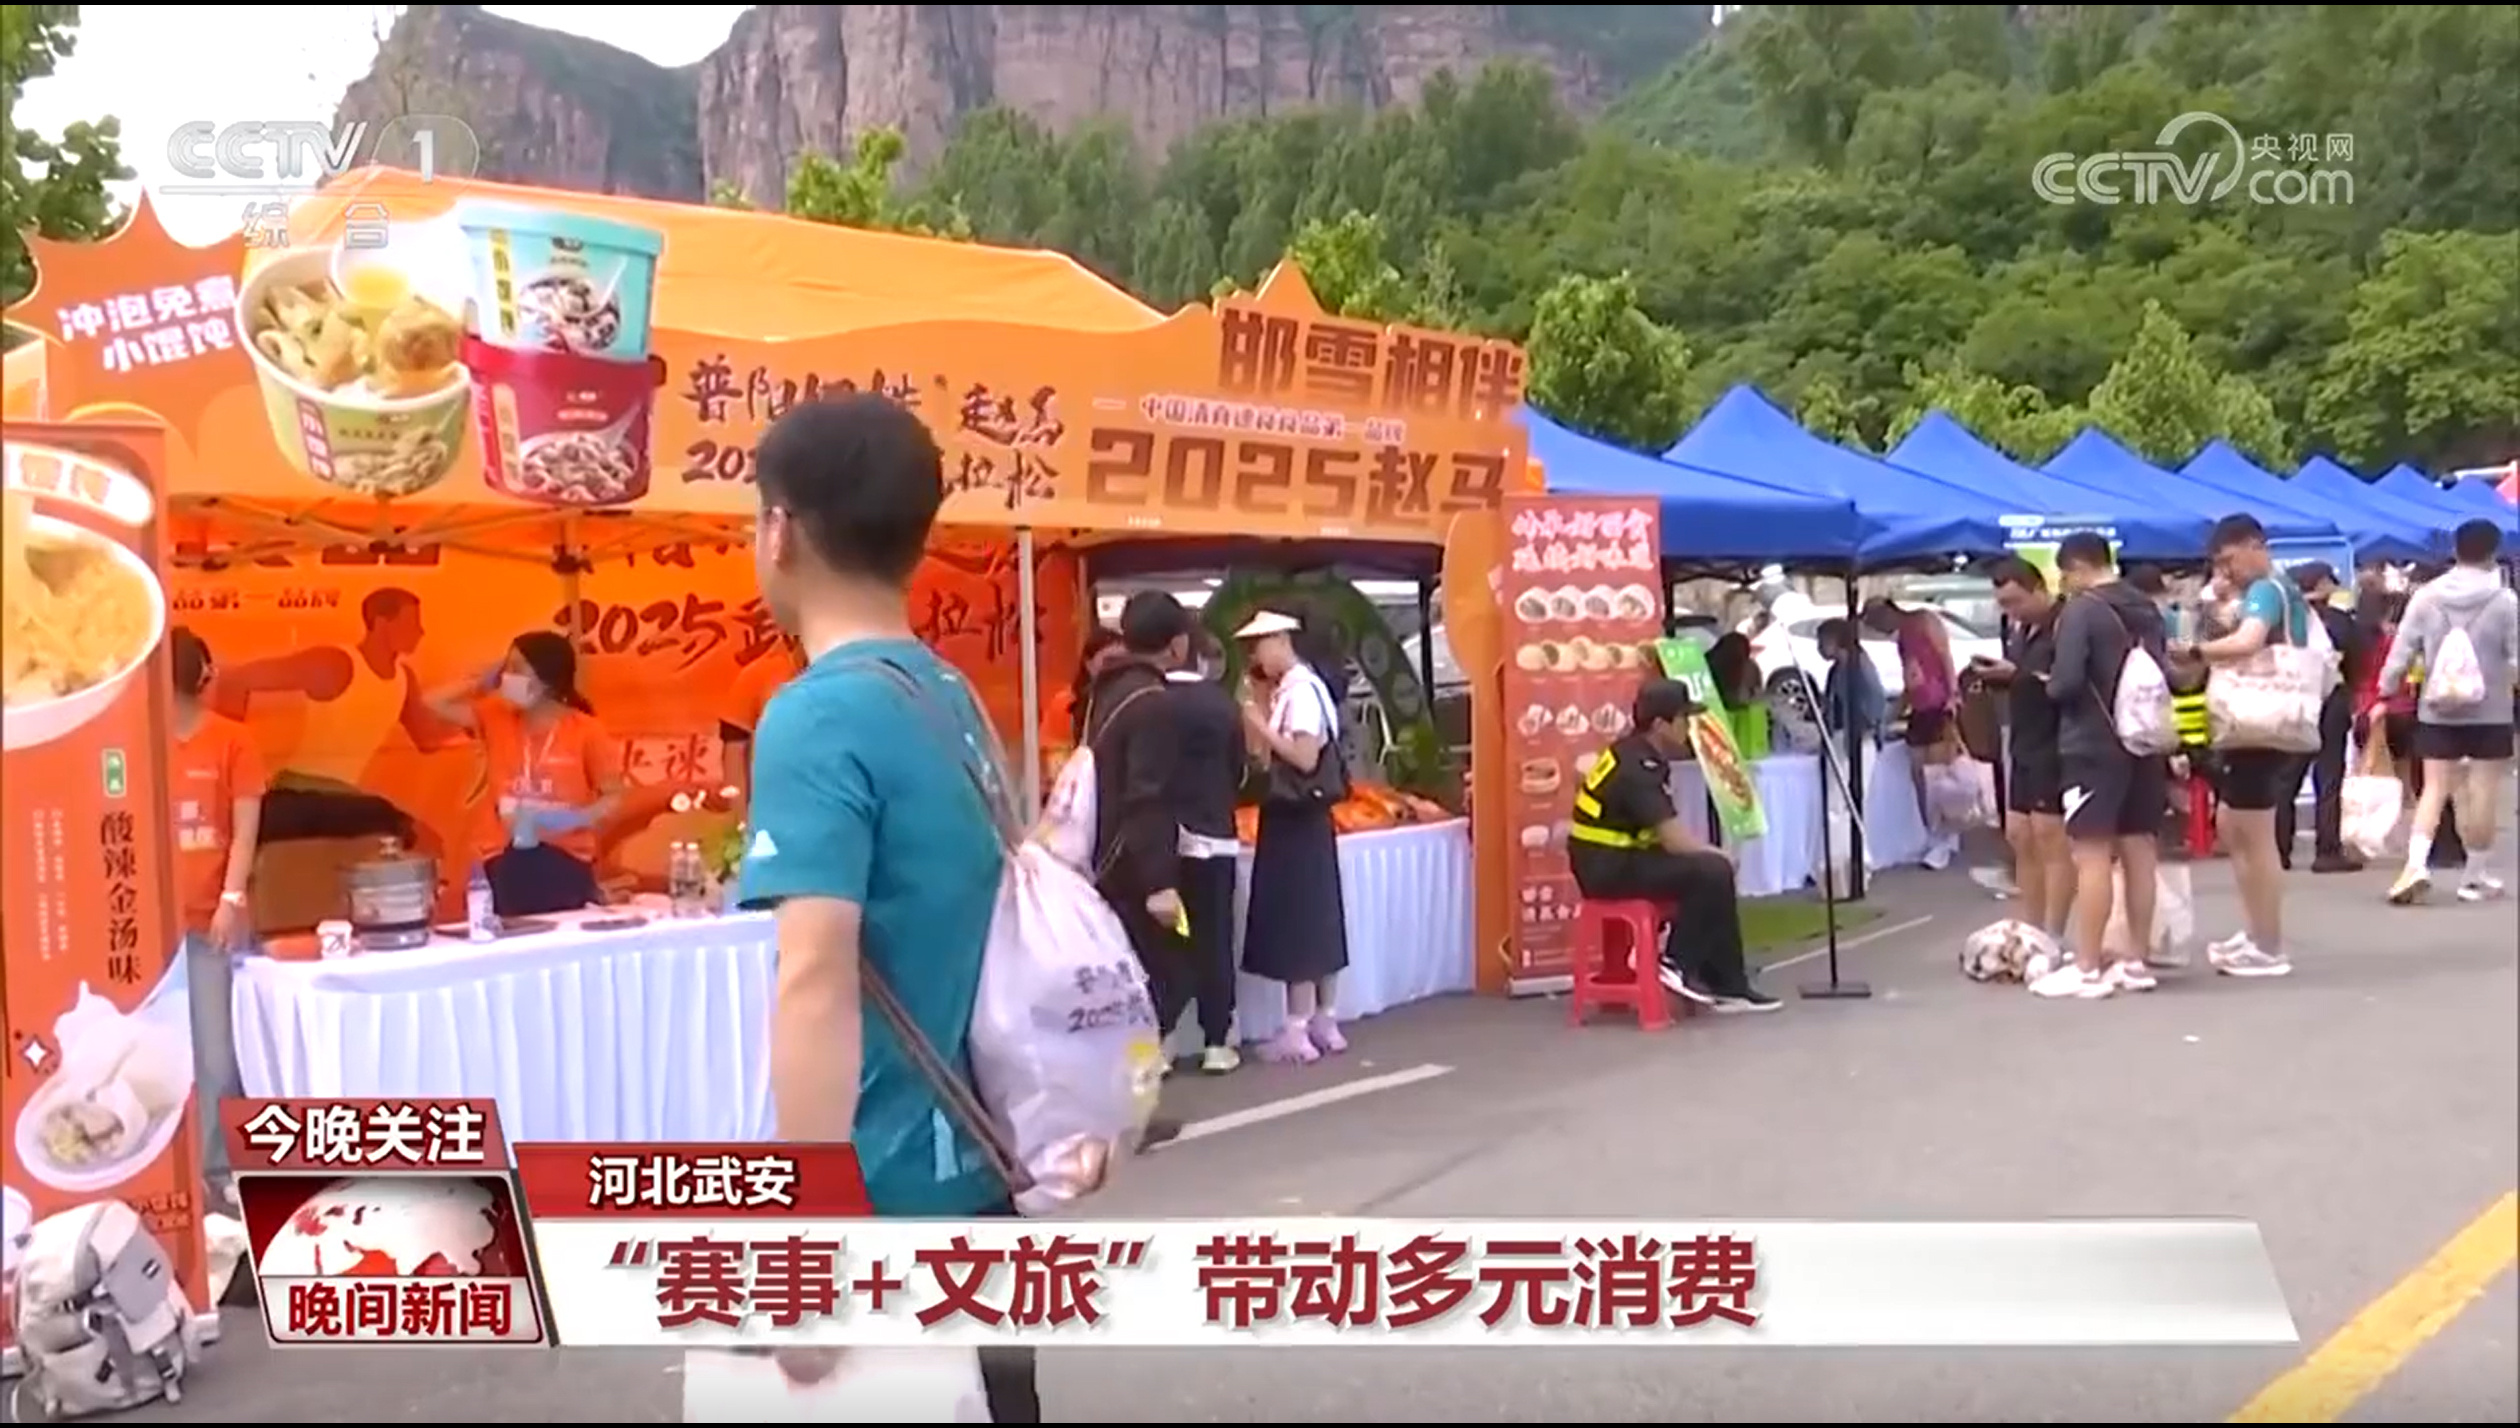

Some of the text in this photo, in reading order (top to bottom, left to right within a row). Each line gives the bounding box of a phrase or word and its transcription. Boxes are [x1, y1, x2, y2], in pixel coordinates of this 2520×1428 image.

[56, 274, 236, 342] 冲泡免煮
[103, 316, 235, 373] 小馄饨
[1218, 307, 1524, 420] 邯雪相伴
[1086, 427, 1508, 528] 2025赵马
[100, 811, 142, 985] 酸辣金汤味
